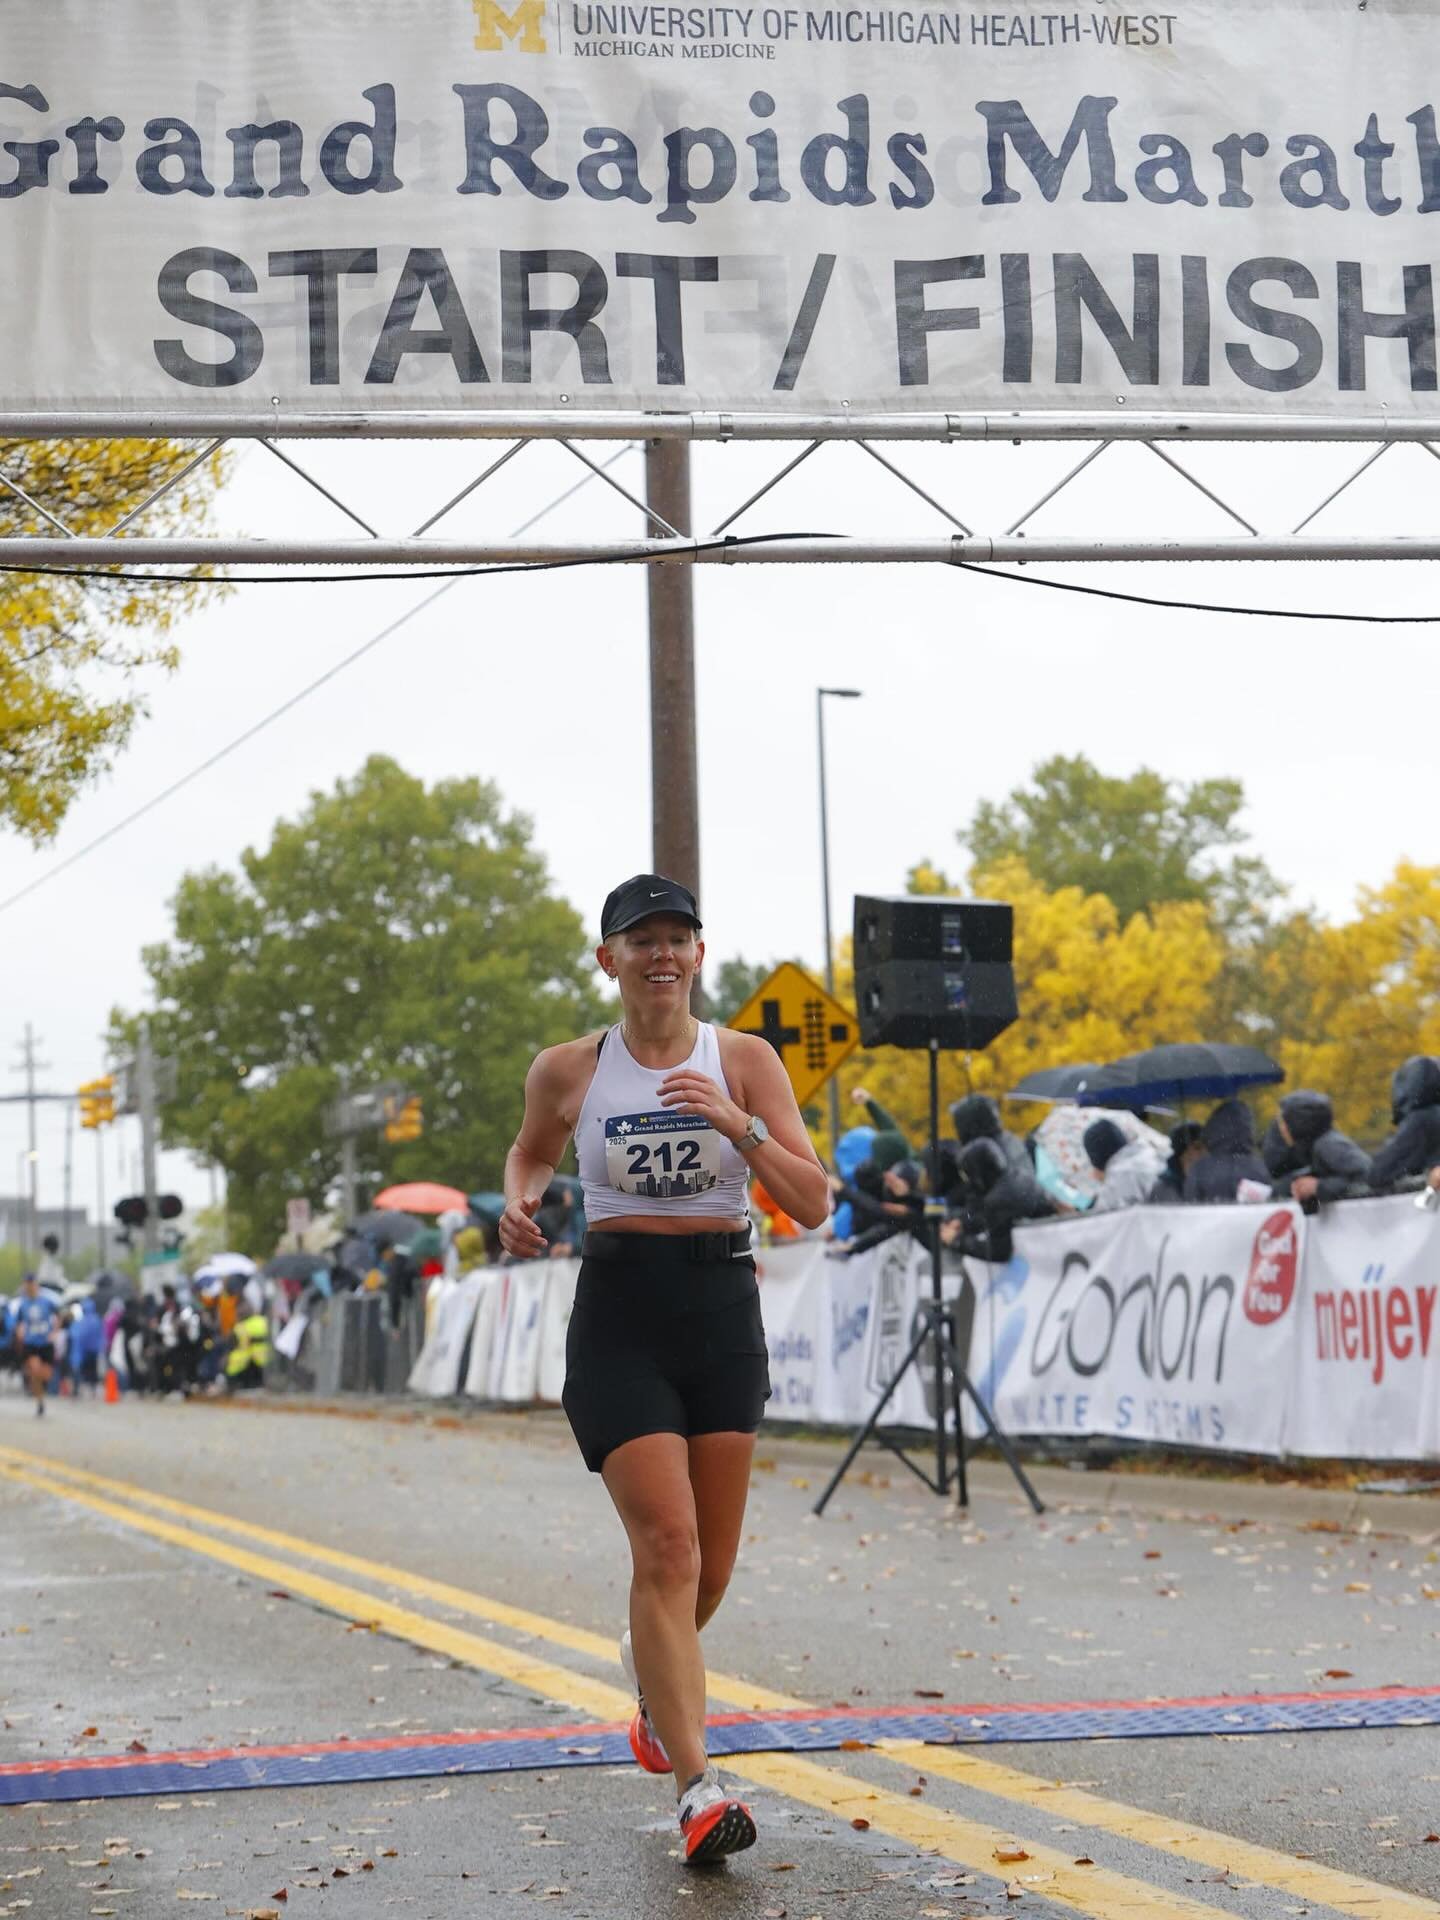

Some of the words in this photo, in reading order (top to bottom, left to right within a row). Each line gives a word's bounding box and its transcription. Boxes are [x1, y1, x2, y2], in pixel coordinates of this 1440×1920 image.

[573, 3, 753, 39] UNIVERSITY
[763, 10, 799, 41] OF
[806, 9, 960, 45] MICHIGAN
[971, 13, 1177, 47] HEALTH-WEST
[574, 41, 674, 58] MICHIGAN
[682, 43, 775, 60] MEDICINE
[0, 82, 404, 199] Grand
[453, 83, 936, 224] Rapids
[153, 246, 719, 388] START
[894, 253, 1438, 392] FINISH
[609, 1136, 627, 1146] 2025
[634, 1124, 654, 1132] Grand
[655, 1122, 676, 1131] Rapids
[676, 1121, 707, 1130] Marathon
[626, 1140, 701, 1175] 212
[1031, 1233, 1235, 1384] Gordon
[1314, 1263, 1437, 1386] meijer
